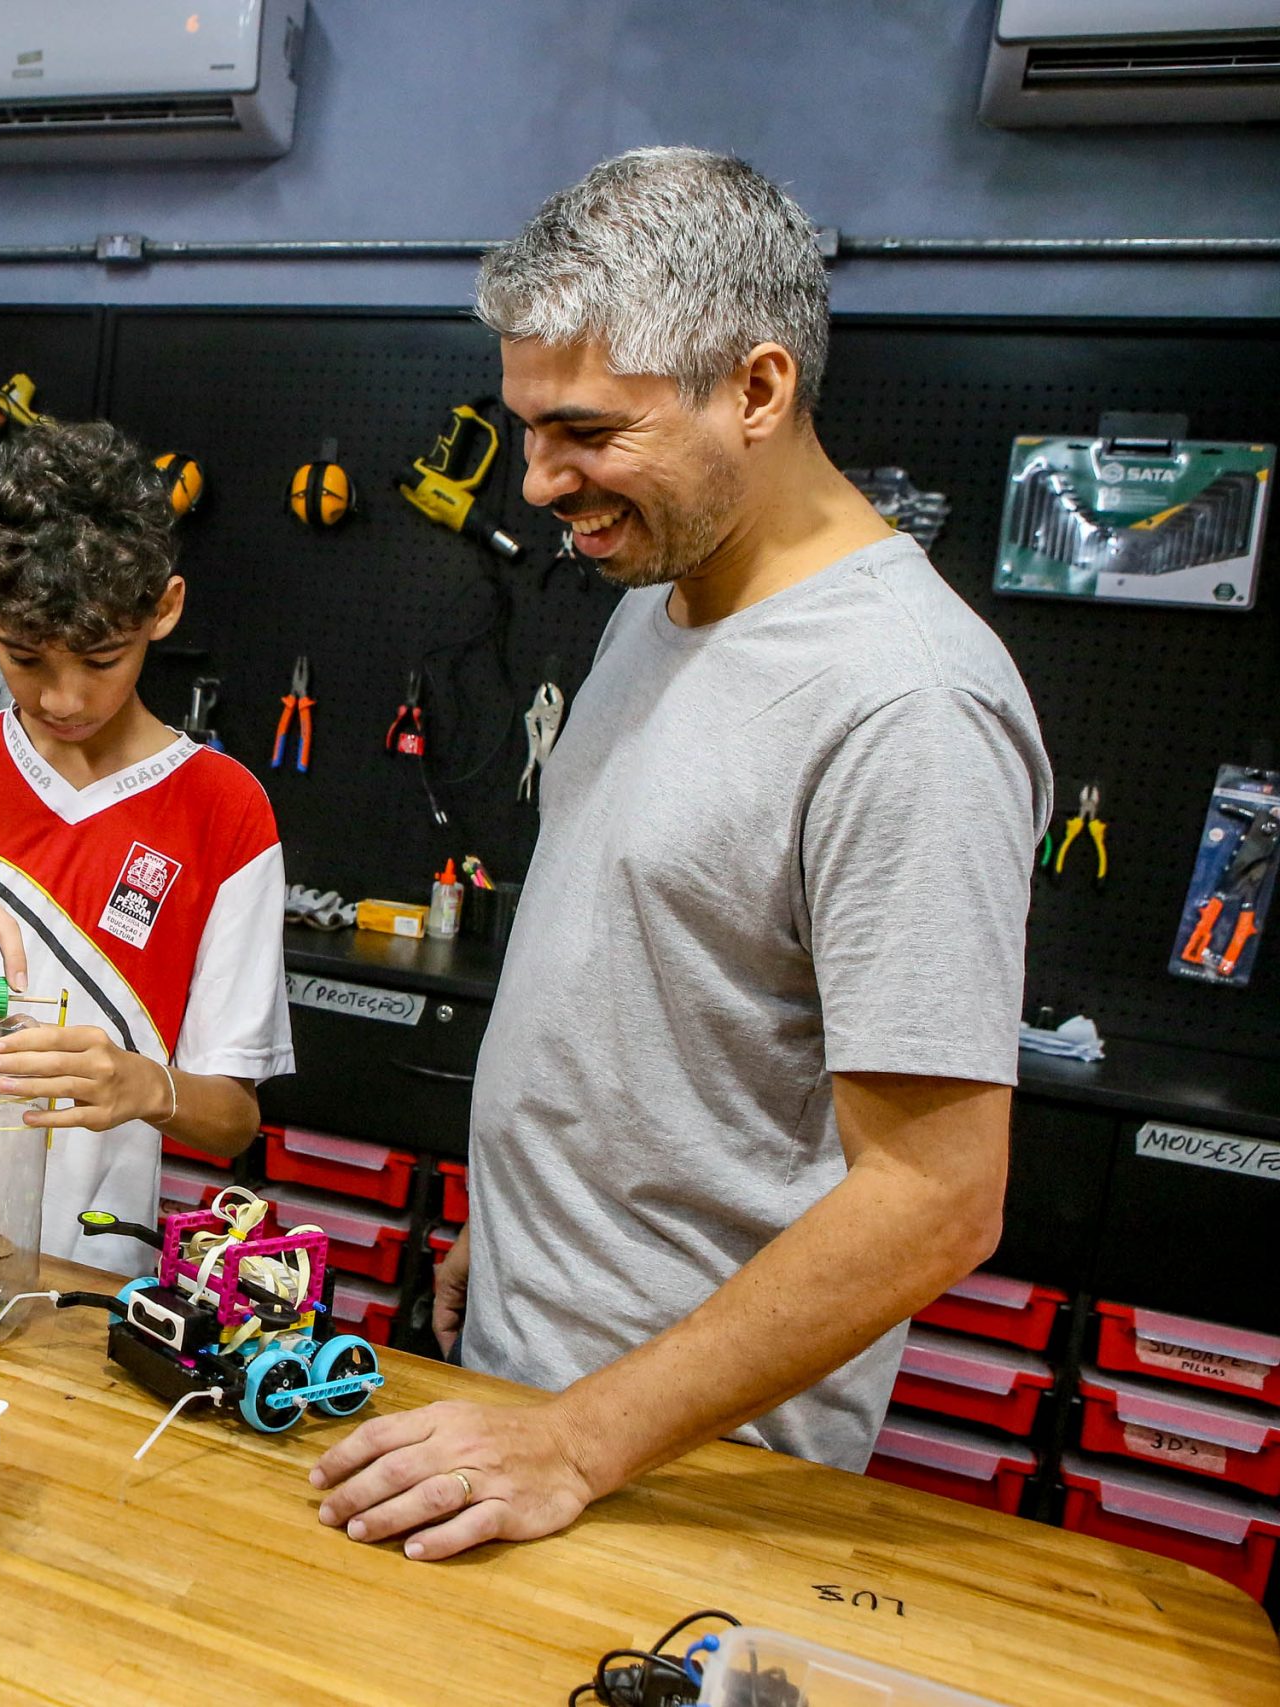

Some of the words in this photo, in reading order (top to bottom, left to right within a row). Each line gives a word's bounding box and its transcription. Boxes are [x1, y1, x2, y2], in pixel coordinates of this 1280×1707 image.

[1127, 467, 1175, 483] SATA
[10, 731, 52, 790] PESSOA
[113, 762, 165, 795] JOÃO
[115, 895, 152, 920] PESSOA
[125, 890, 148, 908] JOÃO
[107, 915, 138, 935] EDUCAÇÃO
[108, 925, 135, 942] CULTURA
[1181, 1361, 1226, 1377] PILHAS
